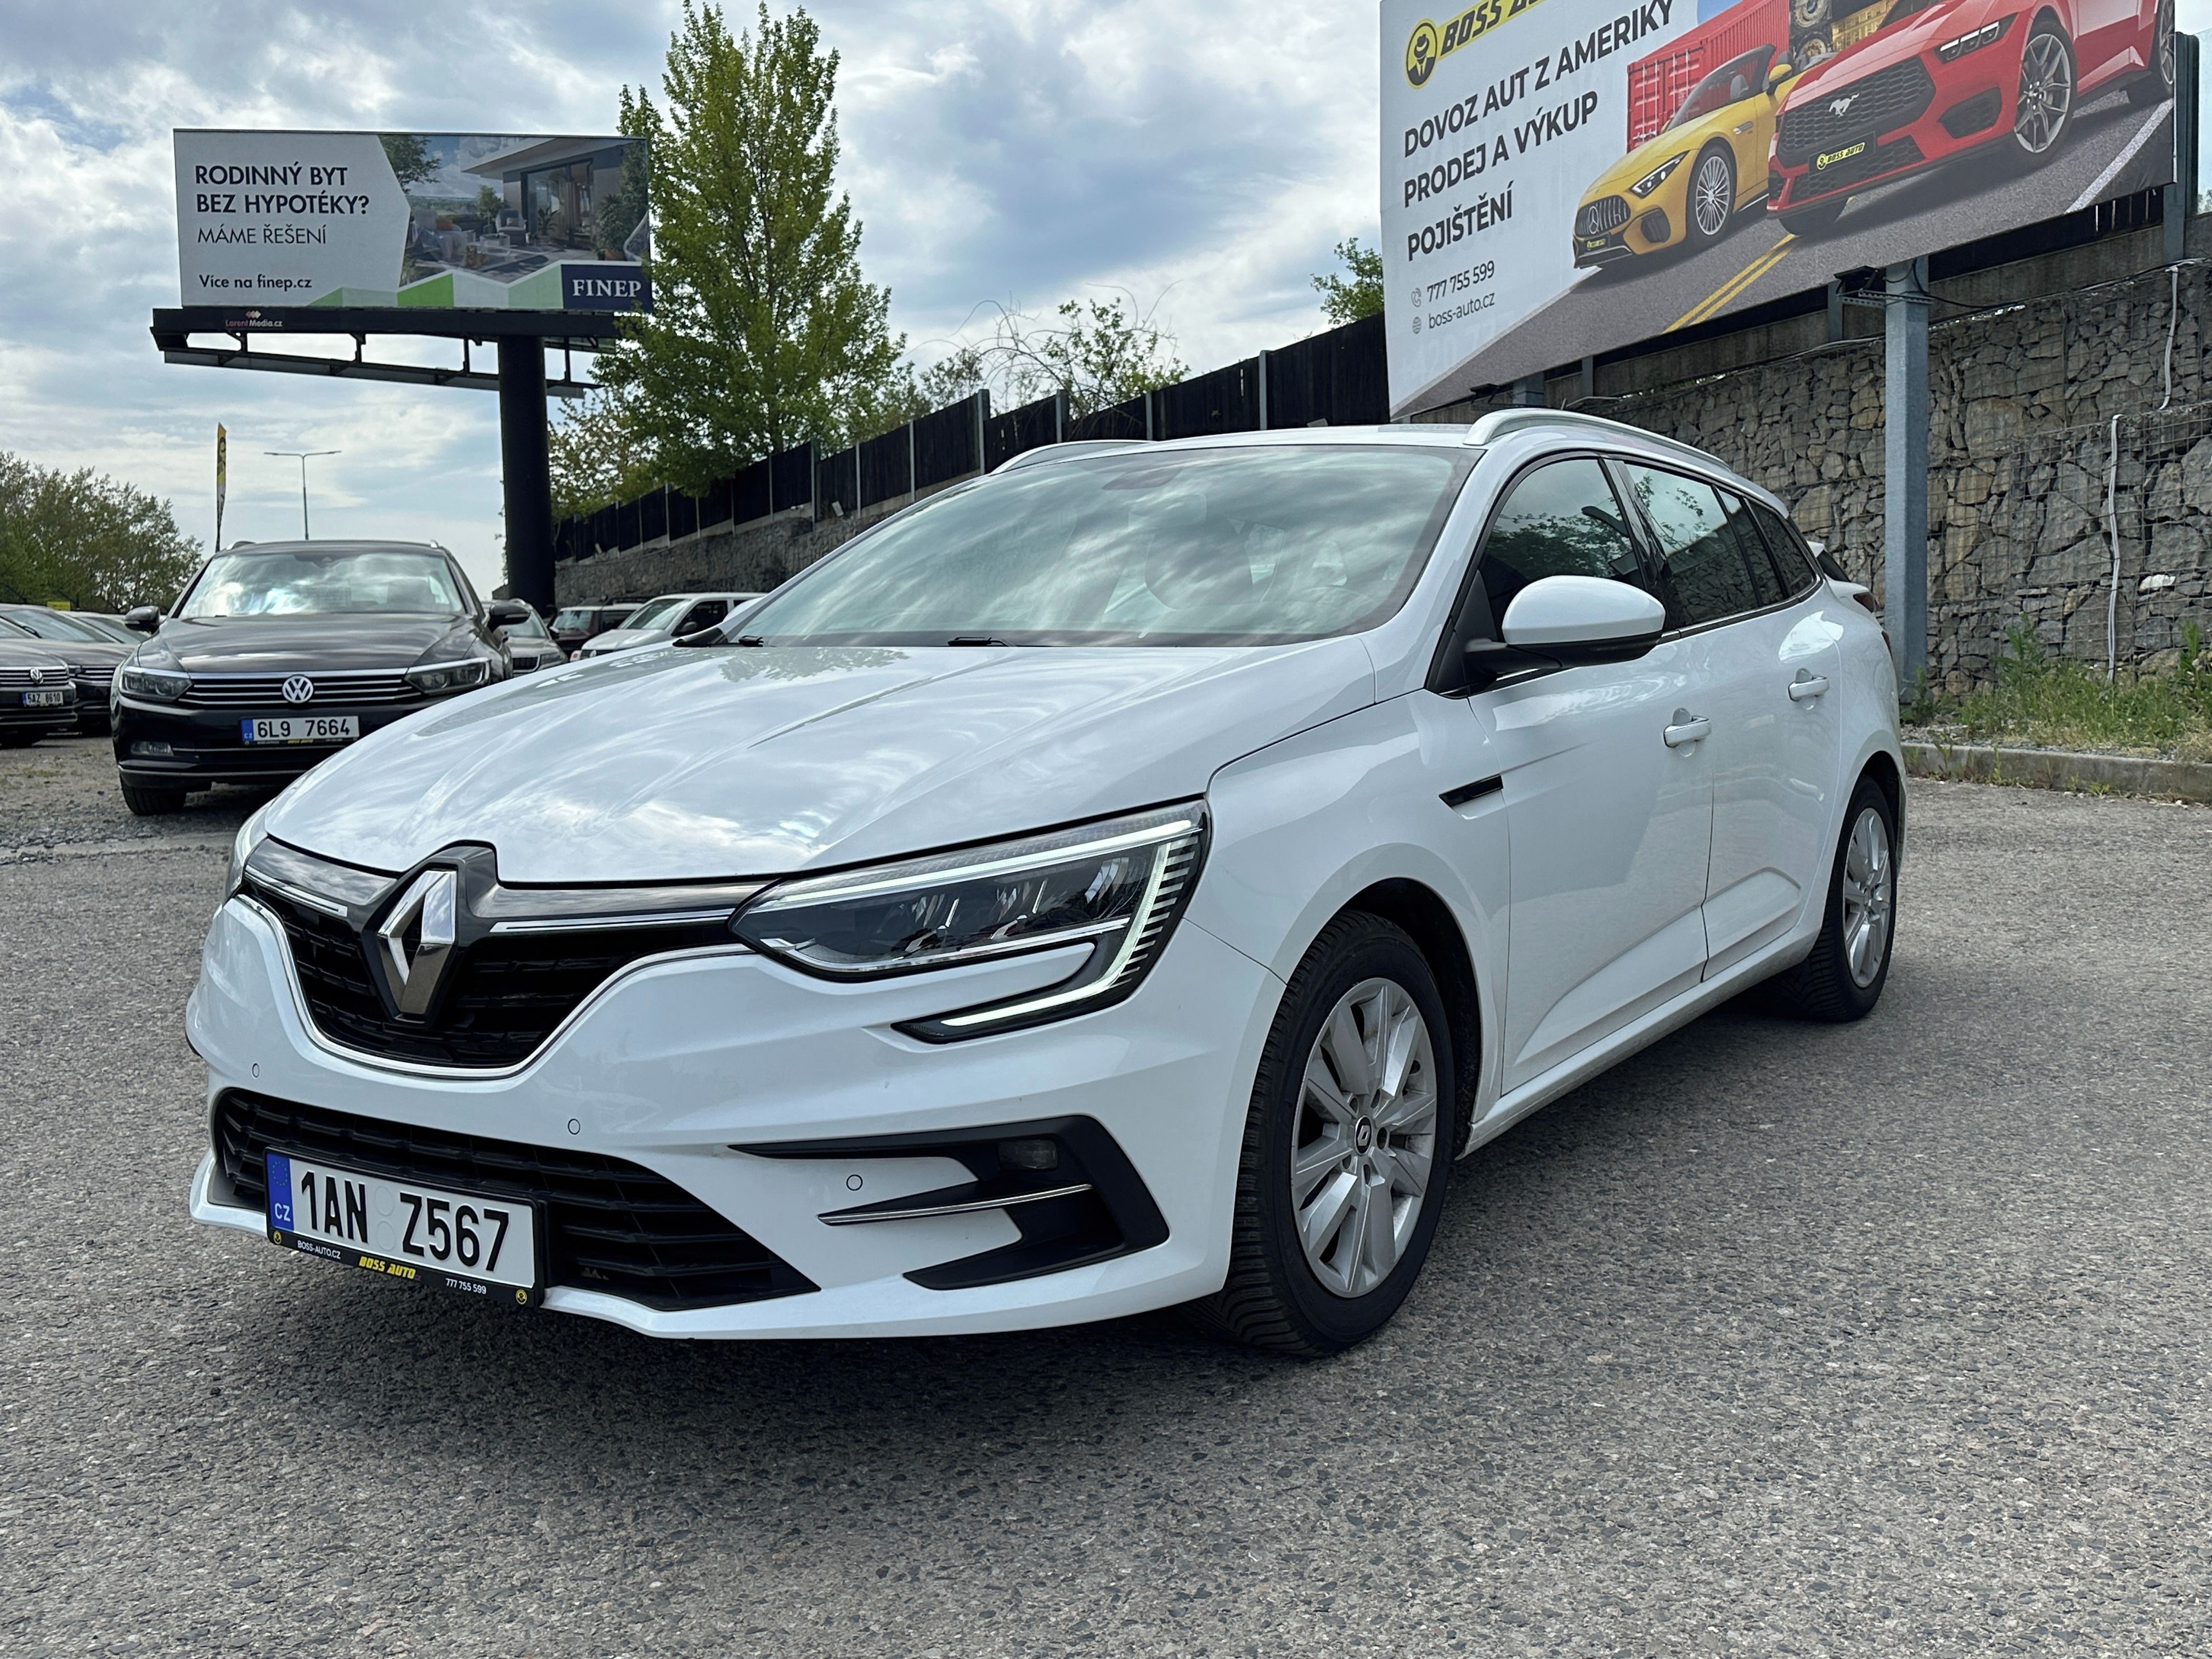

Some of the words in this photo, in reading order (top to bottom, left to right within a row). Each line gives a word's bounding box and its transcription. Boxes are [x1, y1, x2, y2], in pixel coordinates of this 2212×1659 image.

[1440, 0, 1502, 57] BOSS
[1404, 94, 1478, 157] DOVOZ
[1482, 67, 1530, 118] AUT
[1535, 55, 1550, 91] Z
[1555, 0, 1673, 82] AMERIKY
[1404, 143, 1486, 208] PRODEJ
[1491, 134, 1510, 167] A
[1514, 91, 1598, 155] VÝKUP
[195, 161, 303, 185] RODINNÝ
[309, 167, 348, 185] BYT
[196, 194, 236, 213] BEZ
[245, 189, 370, 214] HYPOTÉKY?
[198, 223, 256, 244] MÁME
[263, 224, 327, 244] ŘEŠENÍ
[1407, 180, 1514, 262] POJIŠTĚNÍ
[199, 274, 229, 289] Více
[233, 278, 253, 289] na
[257, 273, 312, 292] finep.cz
[572, 279, 641, 297] FINEP
[1427, 279, 1447, 302] 777
[1449, 270, 1470, 294] 755
[1473, 260, 1495, 284] 599
[1428, 292, 1496, 329] boss-auto.cz
[257, 721, 291, 738] 6L9
[305, 718, 351, 737] 7664
[274, 1203, 291, 1223] CZ
[301, 1170, 369, 1244] 1AN
[399, 1192, 510, 1272] Z567
[297, 1240, 341, 1260] BOSS-AUTO.CZ
[358, 1256, 386, 1273] BOSS
[387, 1263, 417, 1279] AUTO
[445, 1278, 458, 1289] 777
[458, 1282, 472, 1292] 755
[472, 1285, 487, 1295] 599
